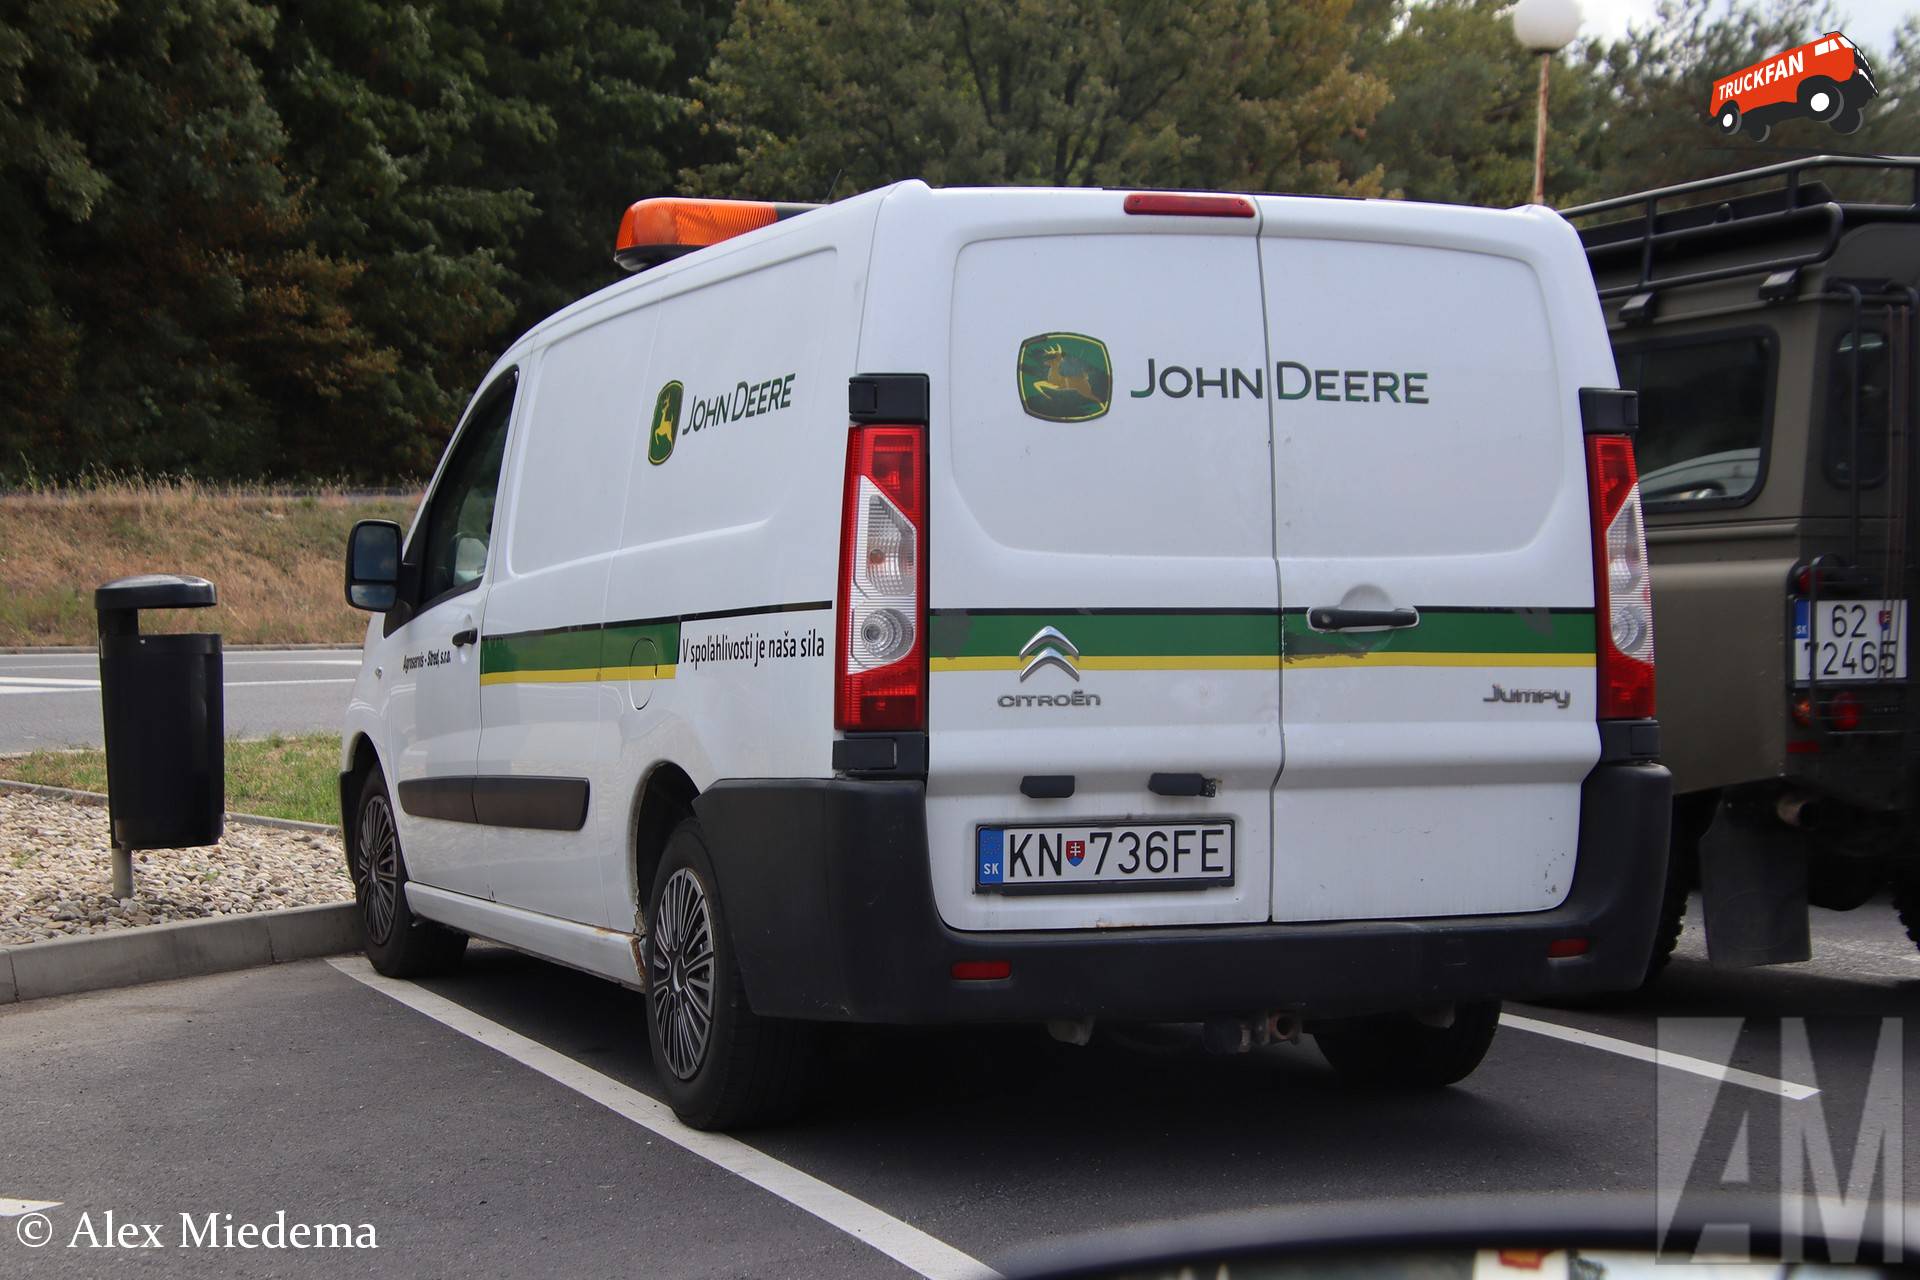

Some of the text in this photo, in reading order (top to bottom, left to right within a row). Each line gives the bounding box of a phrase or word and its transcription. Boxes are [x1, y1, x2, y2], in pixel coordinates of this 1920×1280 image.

[1130, 358, 1430, 404] JOHN DEERE
[682, 373, 796, 436] JOHN DEERE
[1831, 604, 1868, 638] 62
[683, 638, 690, 663] V
[754, 633, 765, 667] je
[768, 631, 796, 658] naša
[800, 628, 825, 657] sila
[1483, 684, 1571, 709] Jumpy
[984, 863, 999, 874] SK
